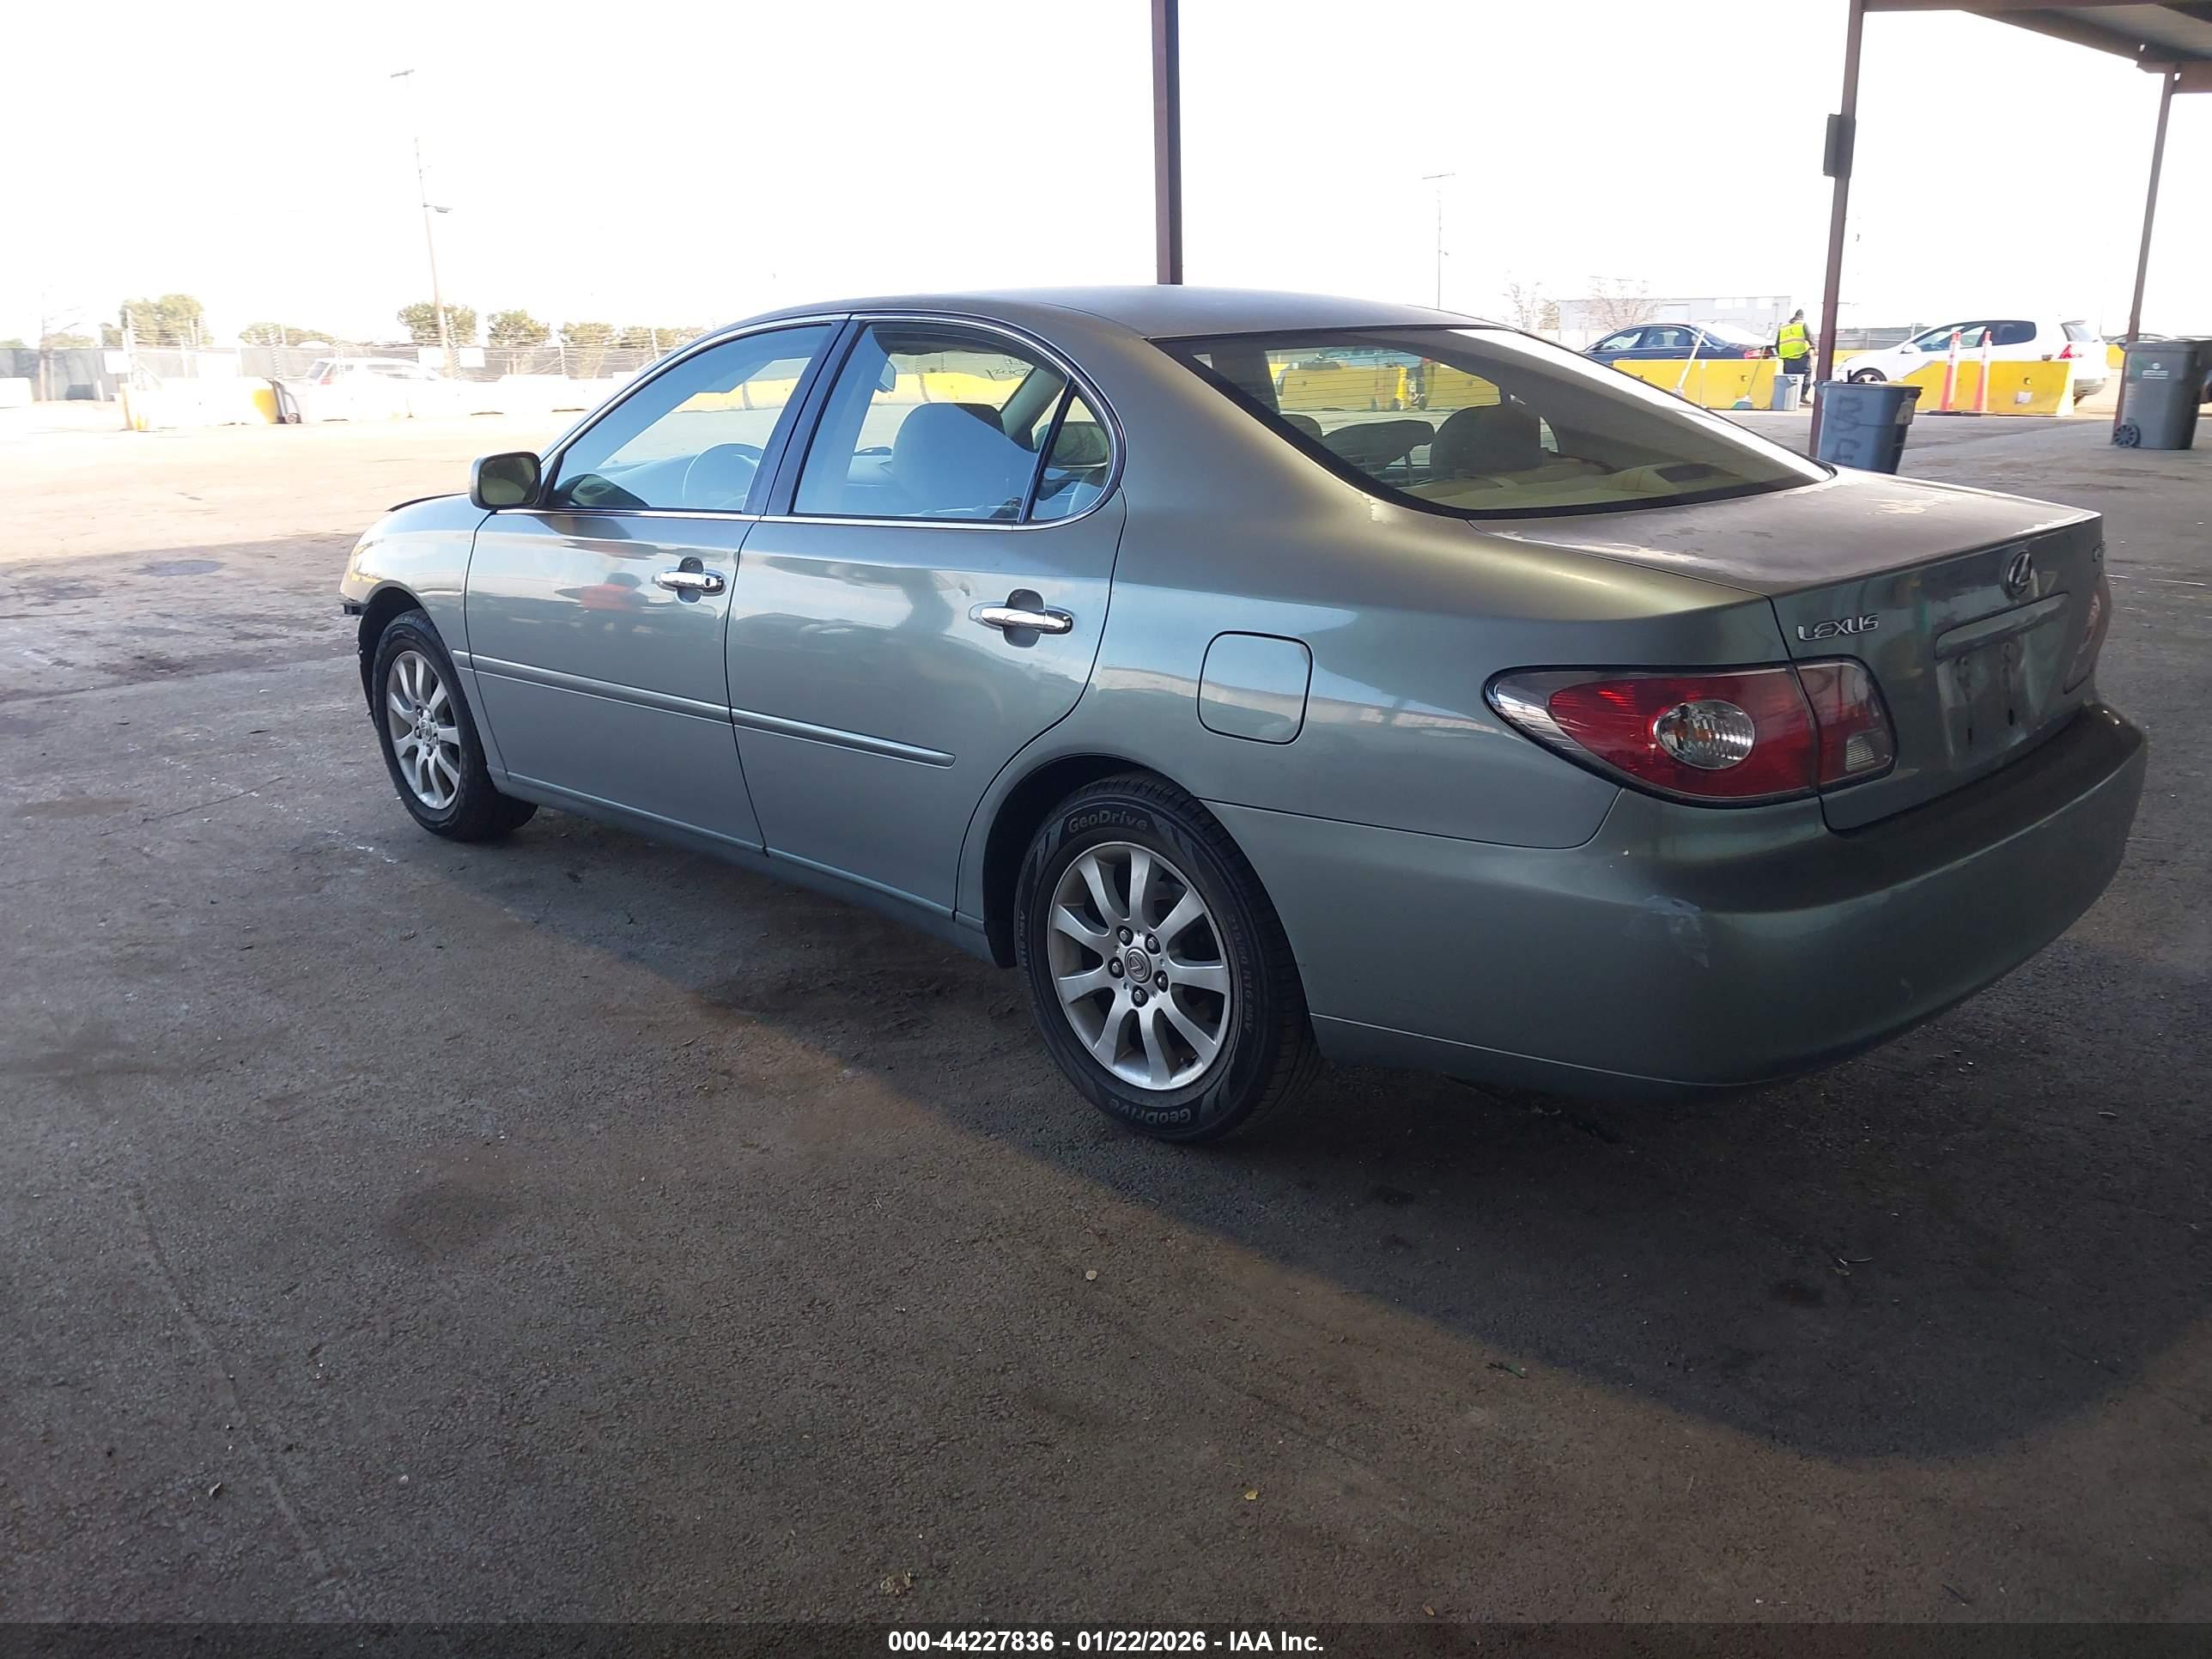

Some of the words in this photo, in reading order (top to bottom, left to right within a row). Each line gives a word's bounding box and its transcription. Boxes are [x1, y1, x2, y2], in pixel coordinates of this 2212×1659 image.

[1797, 614, 1879, 641] LEXUS
[1067, 810, 1148, 833] GeoDrive
[1108, 1098, 1192, 1124] GeoDrive
